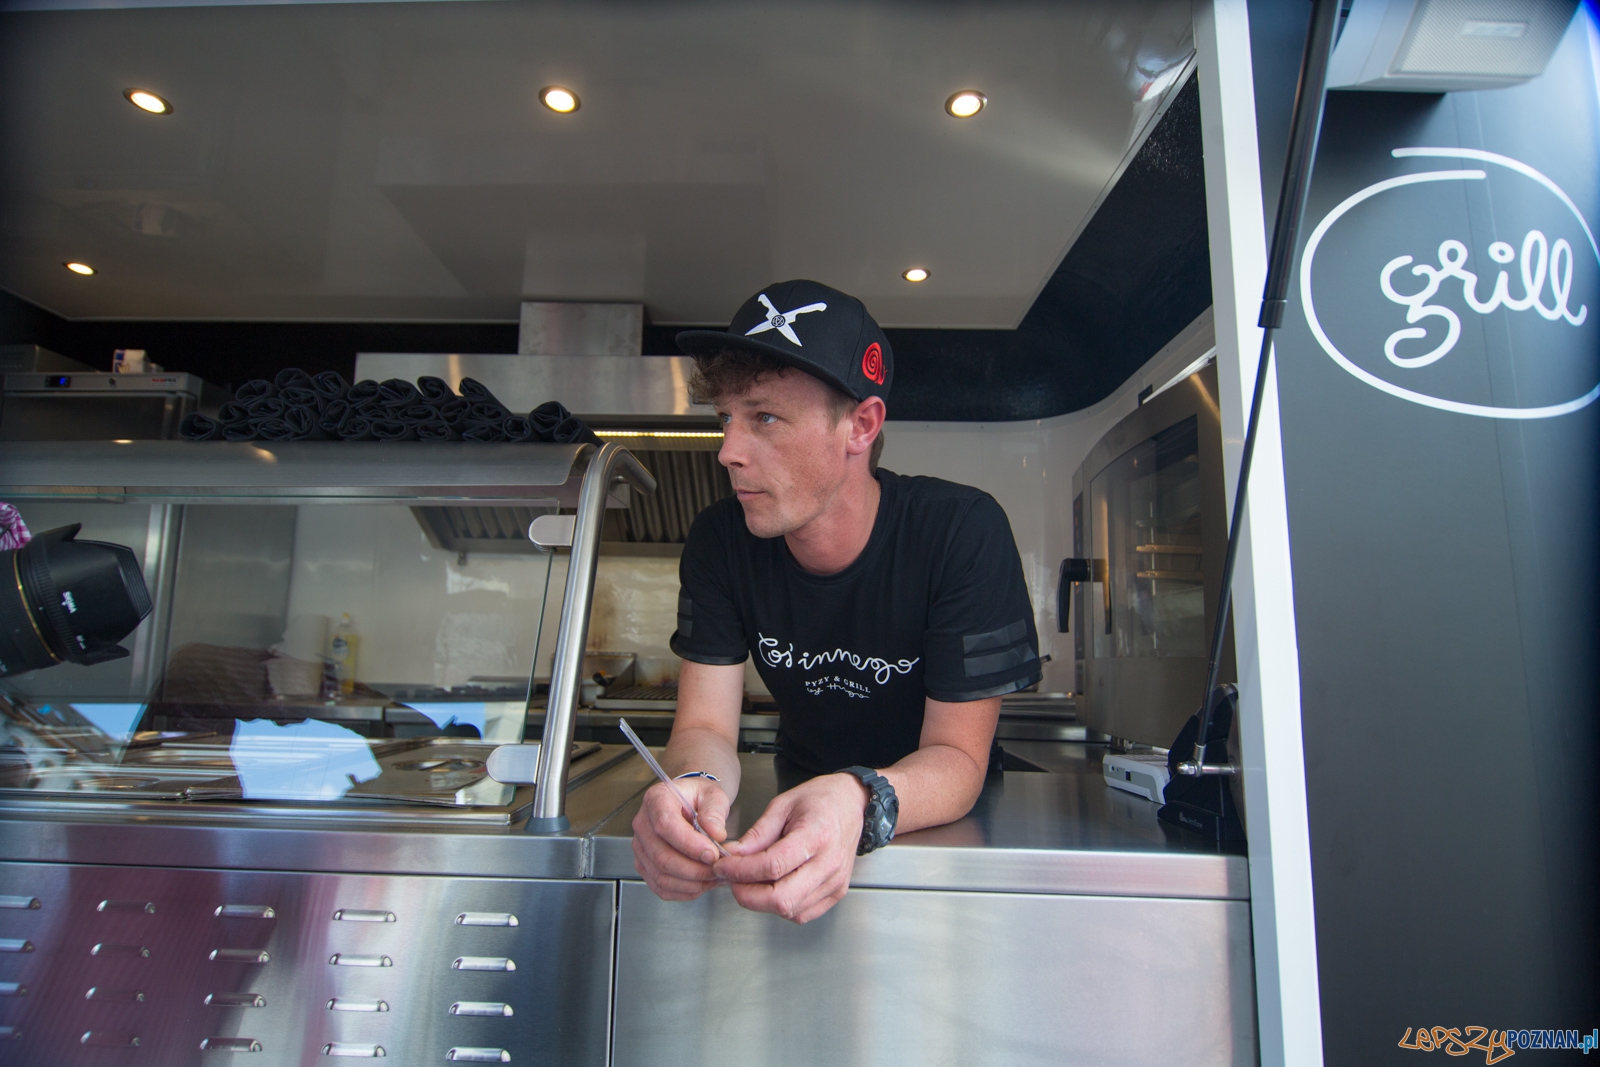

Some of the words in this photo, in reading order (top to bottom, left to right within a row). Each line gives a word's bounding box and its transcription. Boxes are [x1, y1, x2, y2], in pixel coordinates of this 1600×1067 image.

[1380, 230, 1588, 368] grill
[805, 675, 830, 687] PYZY
[843, 678, 871, 694] GRILL
